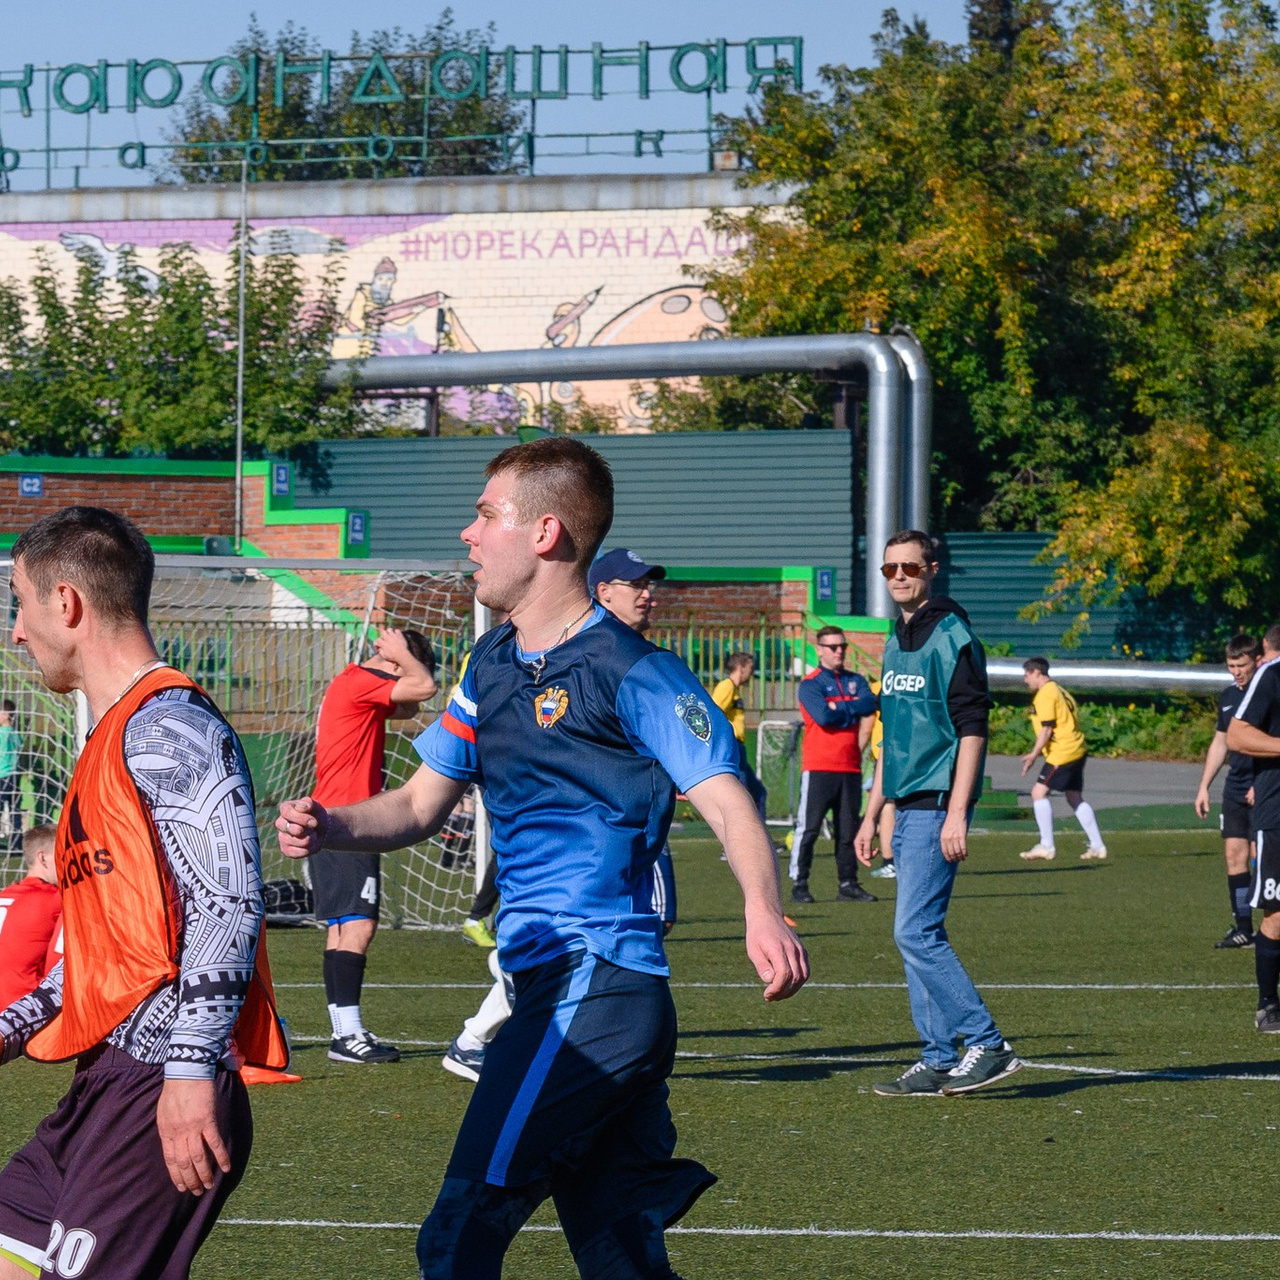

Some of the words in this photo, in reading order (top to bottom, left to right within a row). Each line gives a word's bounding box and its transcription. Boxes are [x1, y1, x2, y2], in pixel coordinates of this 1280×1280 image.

[399, 225, 754, 261] #МОРЕКАРАНДАШ
[360, 876, 377, 905] 4
[41, 1219, 97, 1279] 20
